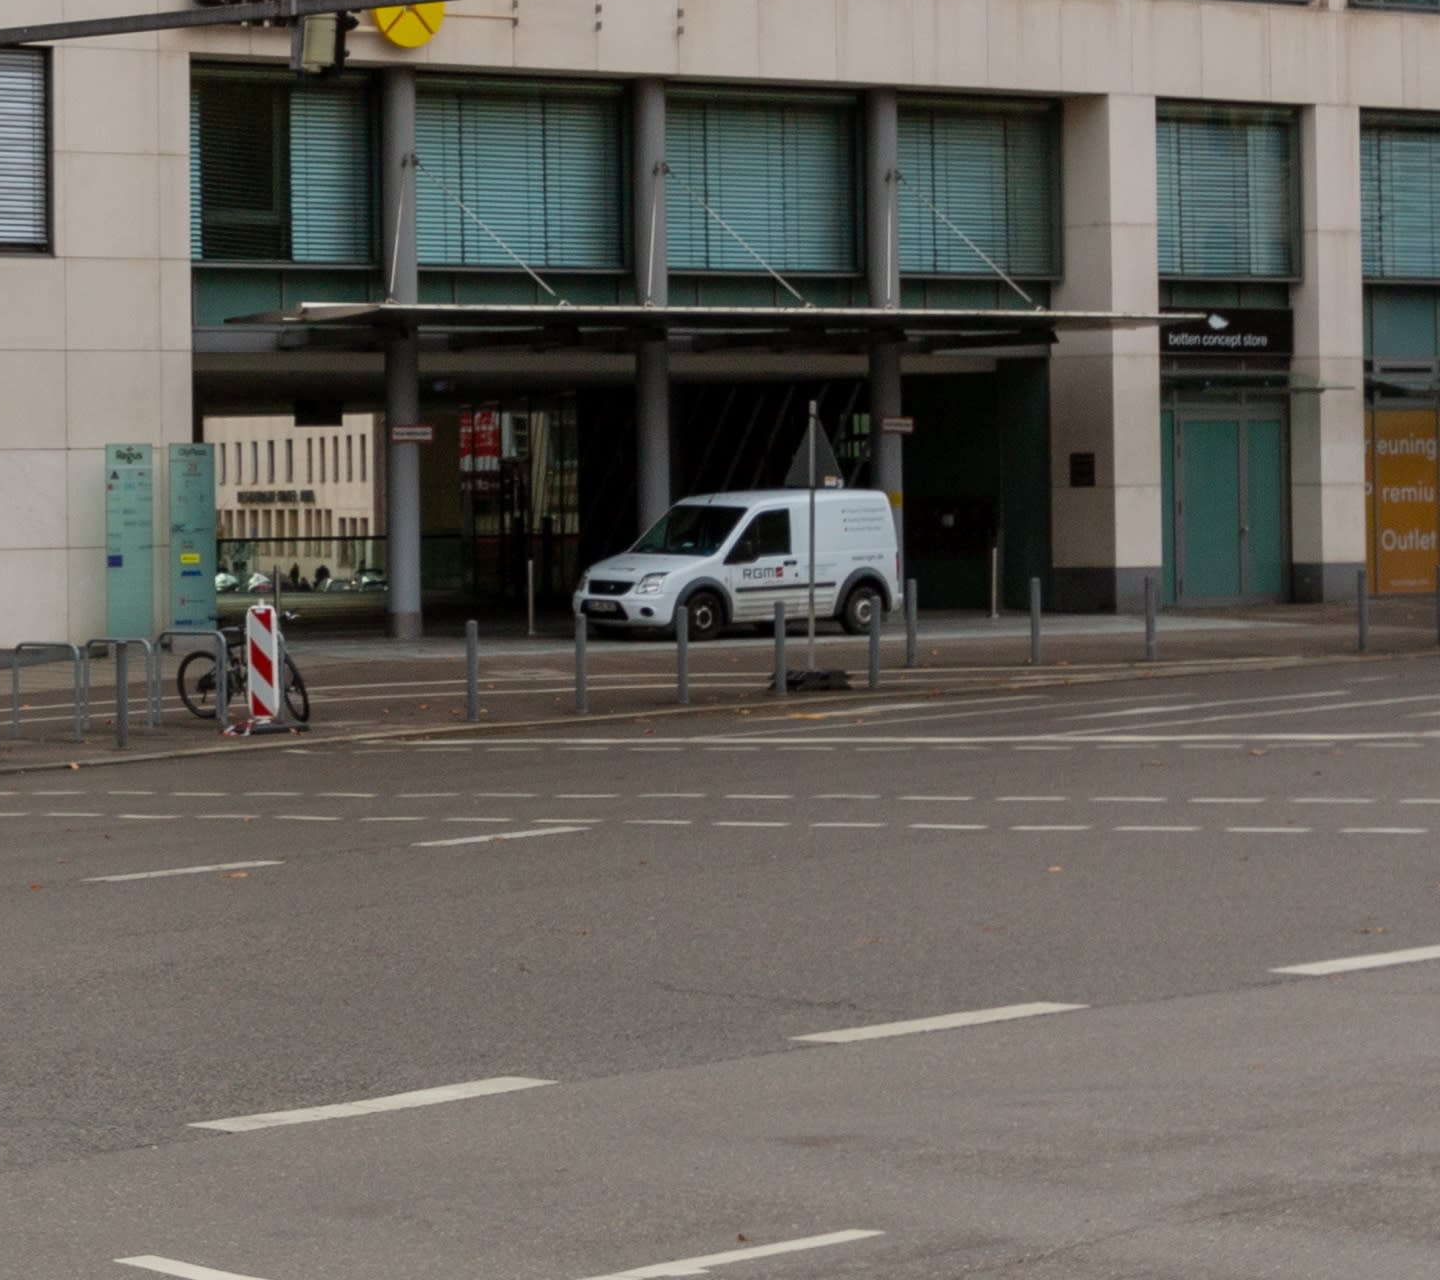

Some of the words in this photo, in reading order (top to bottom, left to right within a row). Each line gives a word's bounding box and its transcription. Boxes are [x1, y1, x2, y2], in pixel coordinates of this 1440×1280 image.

[1168, 332, 1201, 346] betten
[1202, 333, 1241, 348] concept
[1242, 333, 1268, 347] store
[1381, 527, 1438, 552] Outlet
[742, 566, 776, 580] RGM
